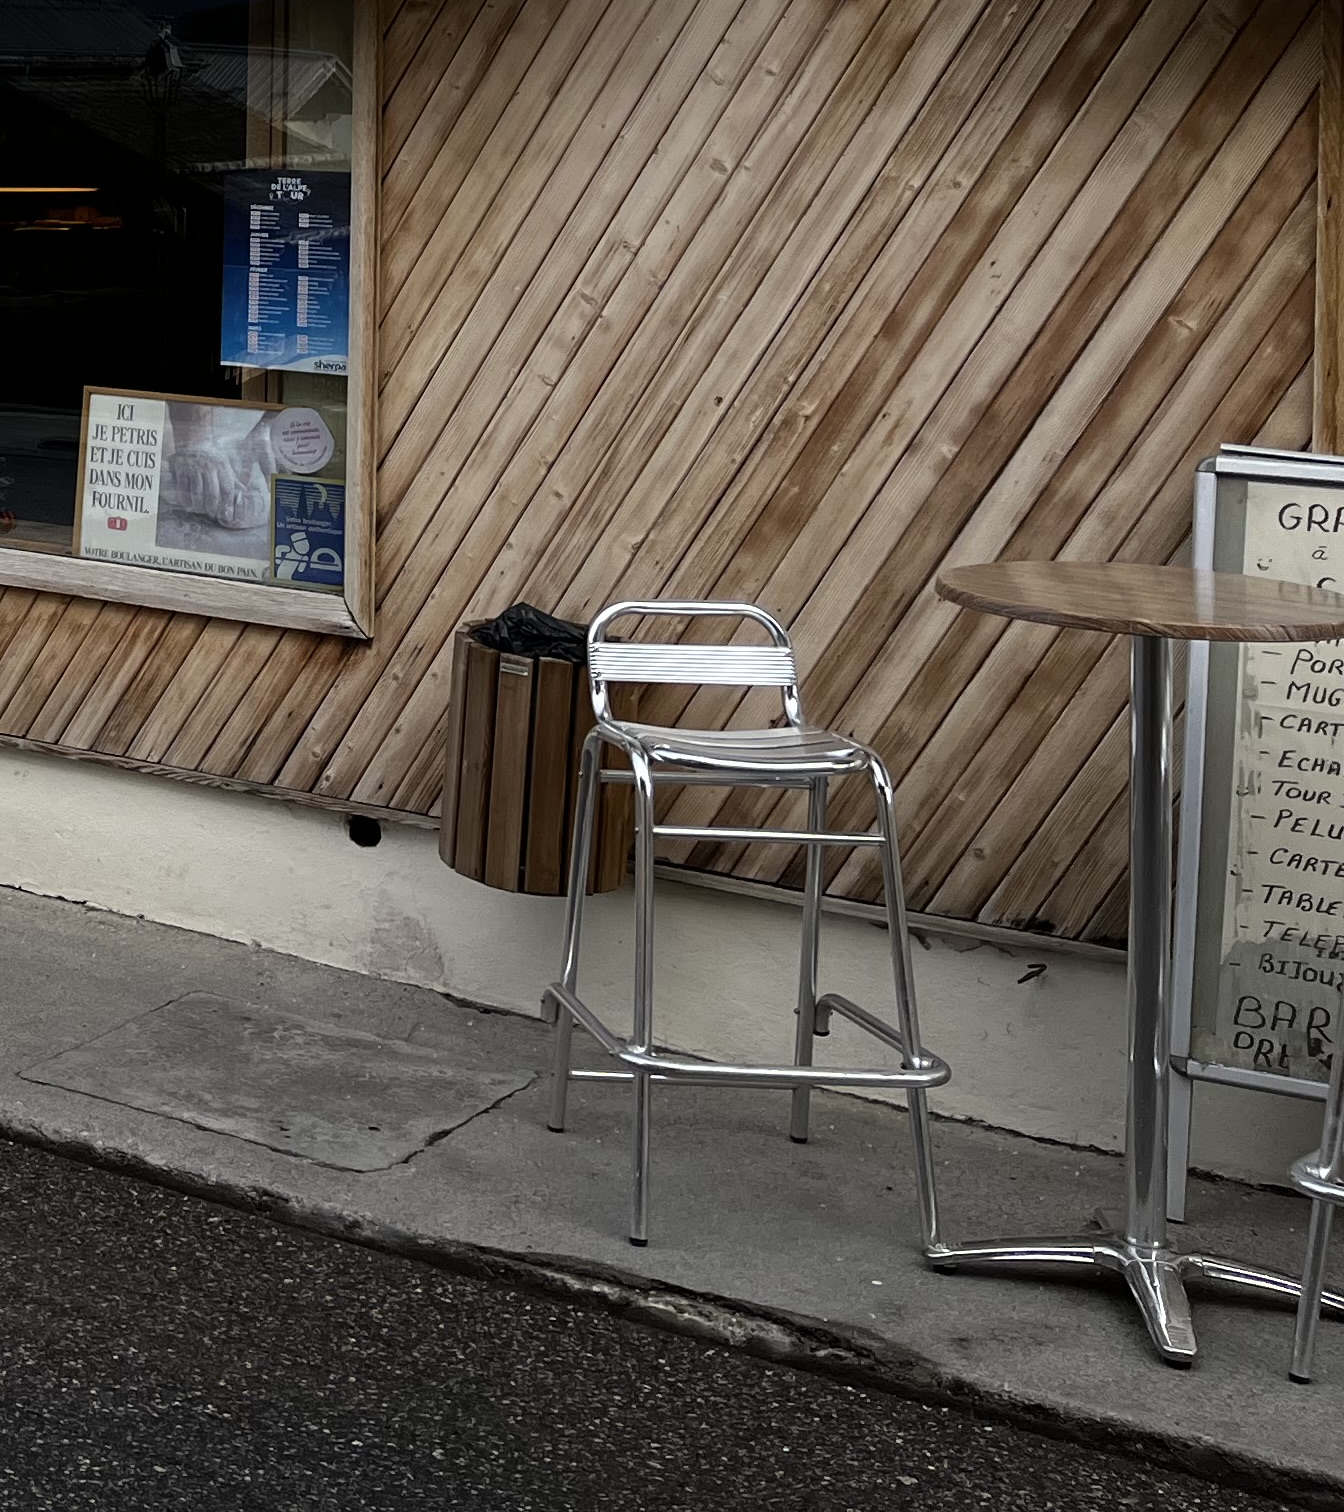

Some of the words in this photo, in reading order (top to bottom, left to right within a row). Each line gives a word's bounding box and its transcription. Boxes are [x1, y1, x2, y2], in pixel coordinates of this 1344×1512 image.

[277, 177, 301, 185] TERRE
[313, 359, 347, 371] sherpa
[117, 403, 134, 422] ICI
[92, 423, 108, 441] JE
[111, 425, 158, 447] PETRIS
[90, 445, 108, 464] ET
[108, 448, 124, 466] JE
[127, 449, 156, 469] CUIS
[89, 468, 121, 488] DANS
[124, 471, 154, 491] MON
[92, 490, 150, 514] FOURNIL.
[84, 546, 110, 558] VOTRE
[162, 557, 206, 571] L'ARTISAN
[205, 562, 217, 573] DU
[218, 564, 235, 576] BON
[1272, 780, 1332, 805] TOUR
[1233, 995, 1333, 1046] BAR
